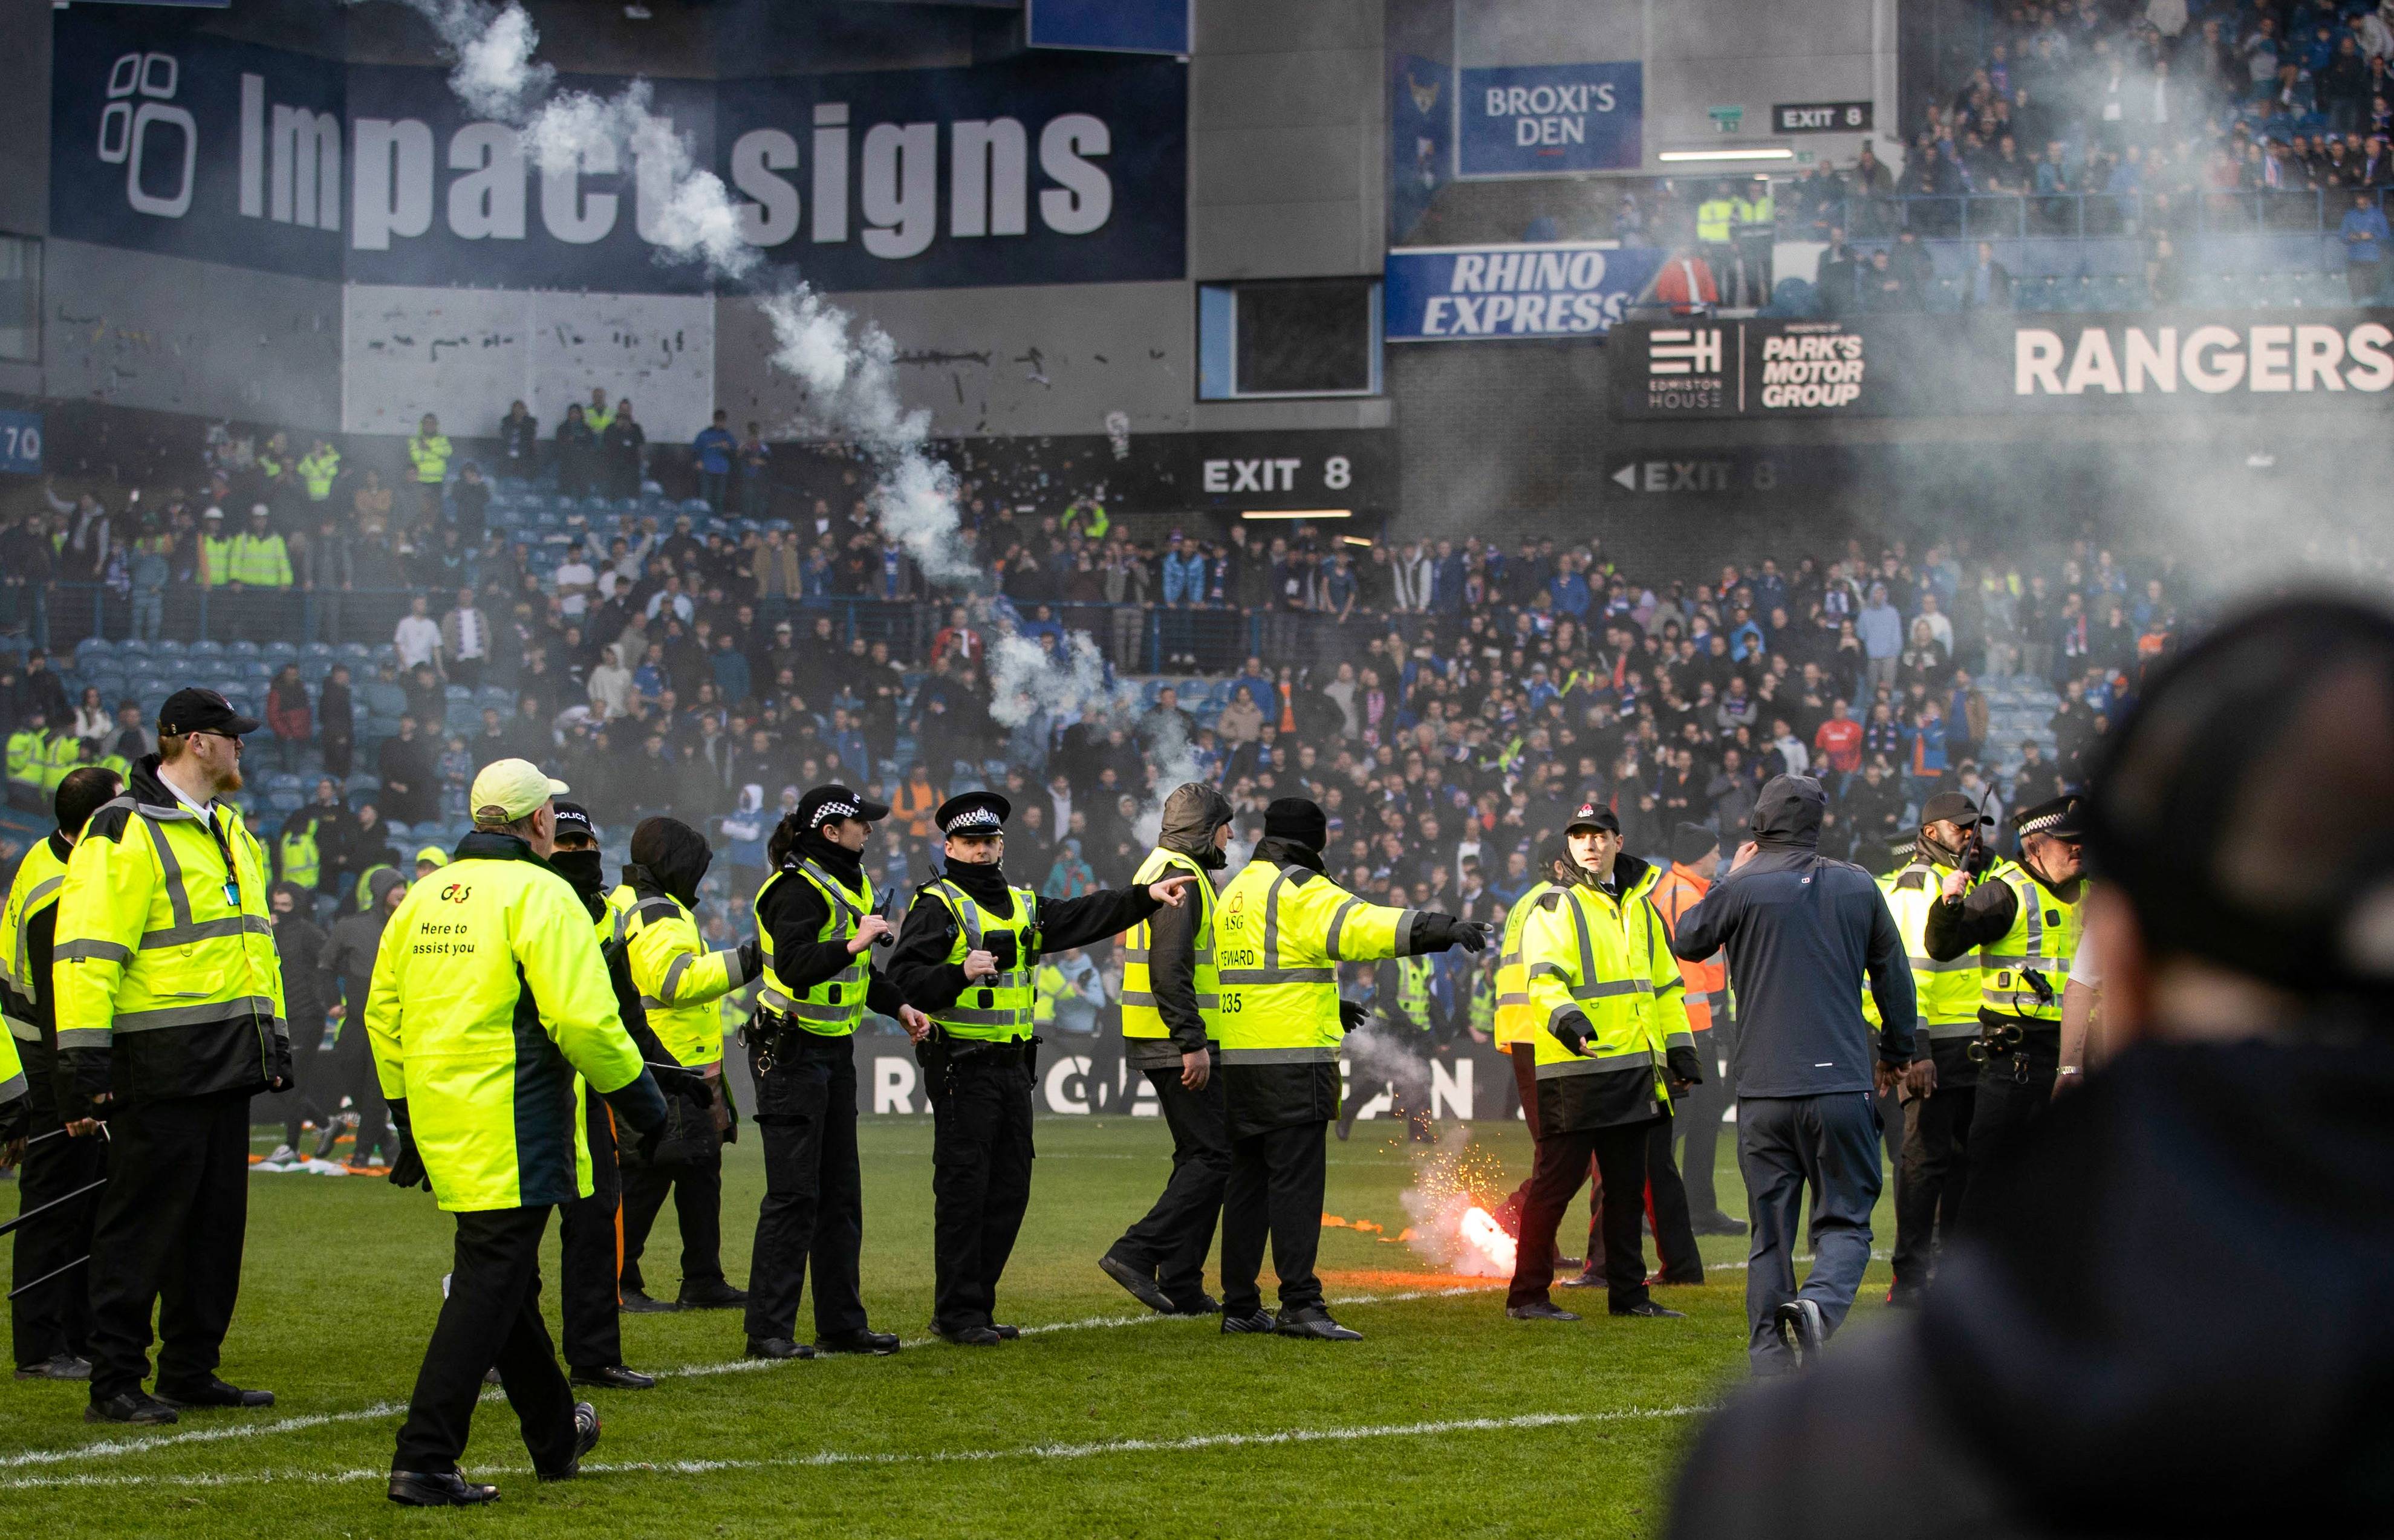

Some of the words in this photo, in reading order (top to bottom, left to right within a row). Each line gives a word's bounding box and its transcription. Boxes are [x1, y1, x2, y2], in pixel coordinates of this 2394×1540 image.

[1486, 84, 1616, 117] BROXI'S
[1783, 108, 1836, 128] EXIT
[1846, 106, 1862, 125] 8
[1515, 117, 1585, 146] DEN
[239, 73, 689, 250] Impact
[730, 103, 1113, 260] signs
[1451, 251, 1606, 293] RHINO
[1422, 292, 1629, 334] EXPRESS
[1762, 334, 1863, 361] PARK'S
[2015, 322, 2394, 395] RANGERS
[1762, 359, 1864, 384] MOTOR
[1648, 392, 1722, 409] HOUSE
[1761, 383, 1860, 408] GROUP
[1203, 457, 1301, 493] EXIT
[1324, 456, 1351, 490] 8
[1644, 461, 1731, 492] EXIT
[554, 811, 587, 823] POLICE
[441, 884, 472, 903] G4S
[421, 923, 451, 934] Here
[455, 923, 467, 934] to
[1224, 915, 1243, 930] ASG
[413, 942, 449, 954] assist
[452, 944, 475, 956] you
